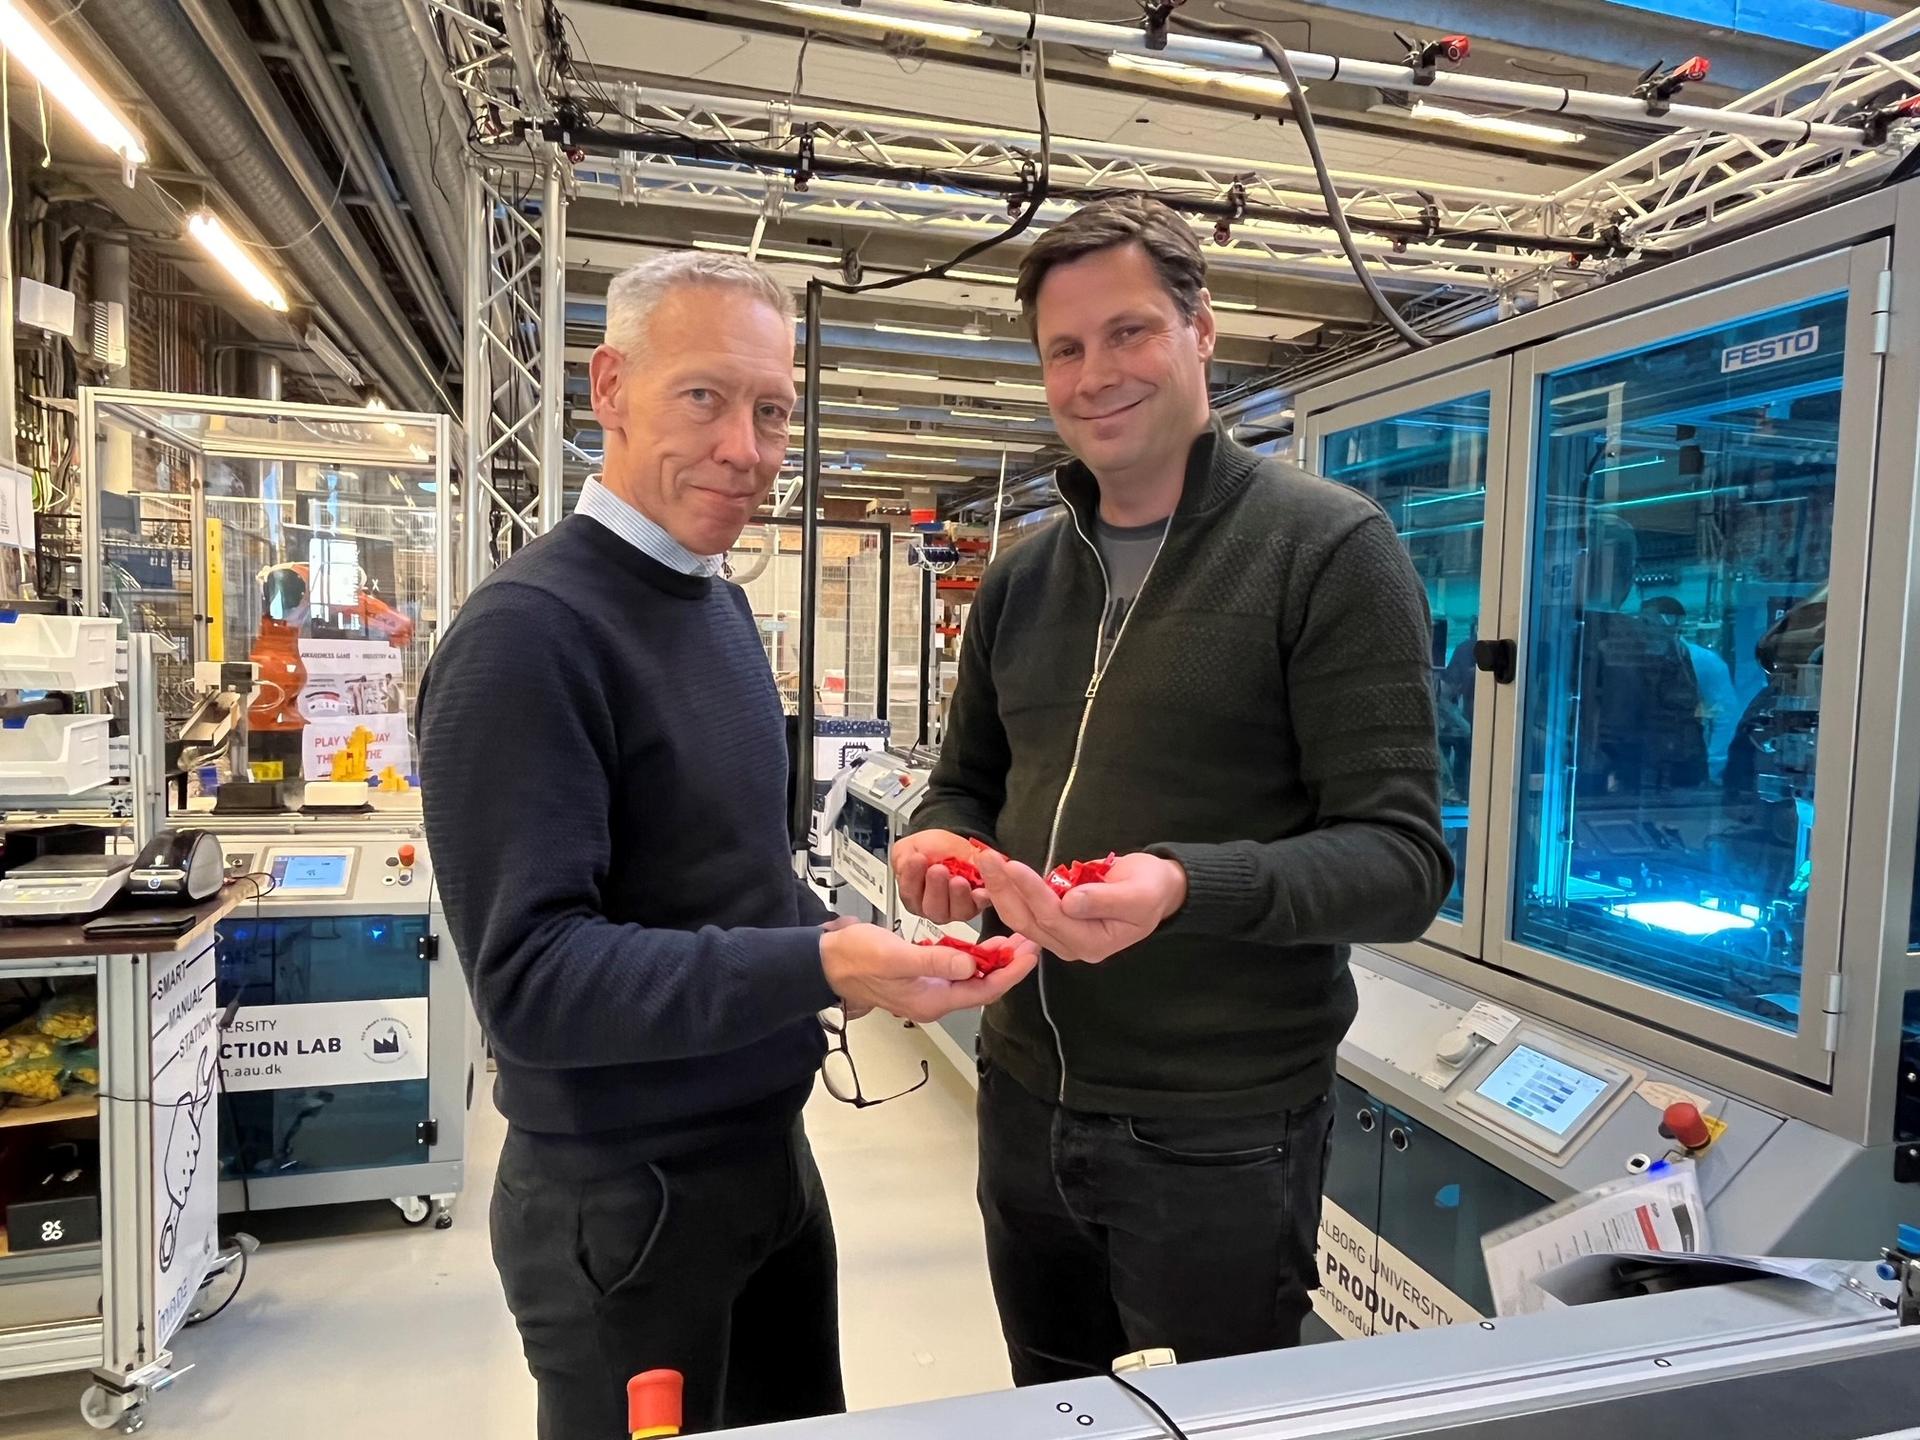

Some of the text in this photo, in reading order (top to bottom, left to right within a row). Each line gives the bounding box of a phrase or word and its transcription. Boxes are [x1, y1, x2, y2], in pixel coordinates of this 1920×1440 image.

[1724, 330, 1814, 369] FESTO
[315, 735, 341, 748] PLAY
[157, 959, 187, 1001] SMART
[168, 985, 203, 1031] MANUAL
[179, 1011, 213, 1059] STATION
[220, 1037, 342, 1060] CTION LAB
[1319, 1286, 1384, 1337] artprodu
[1369, 1253, 1454, 1326] UNIVERSITY
